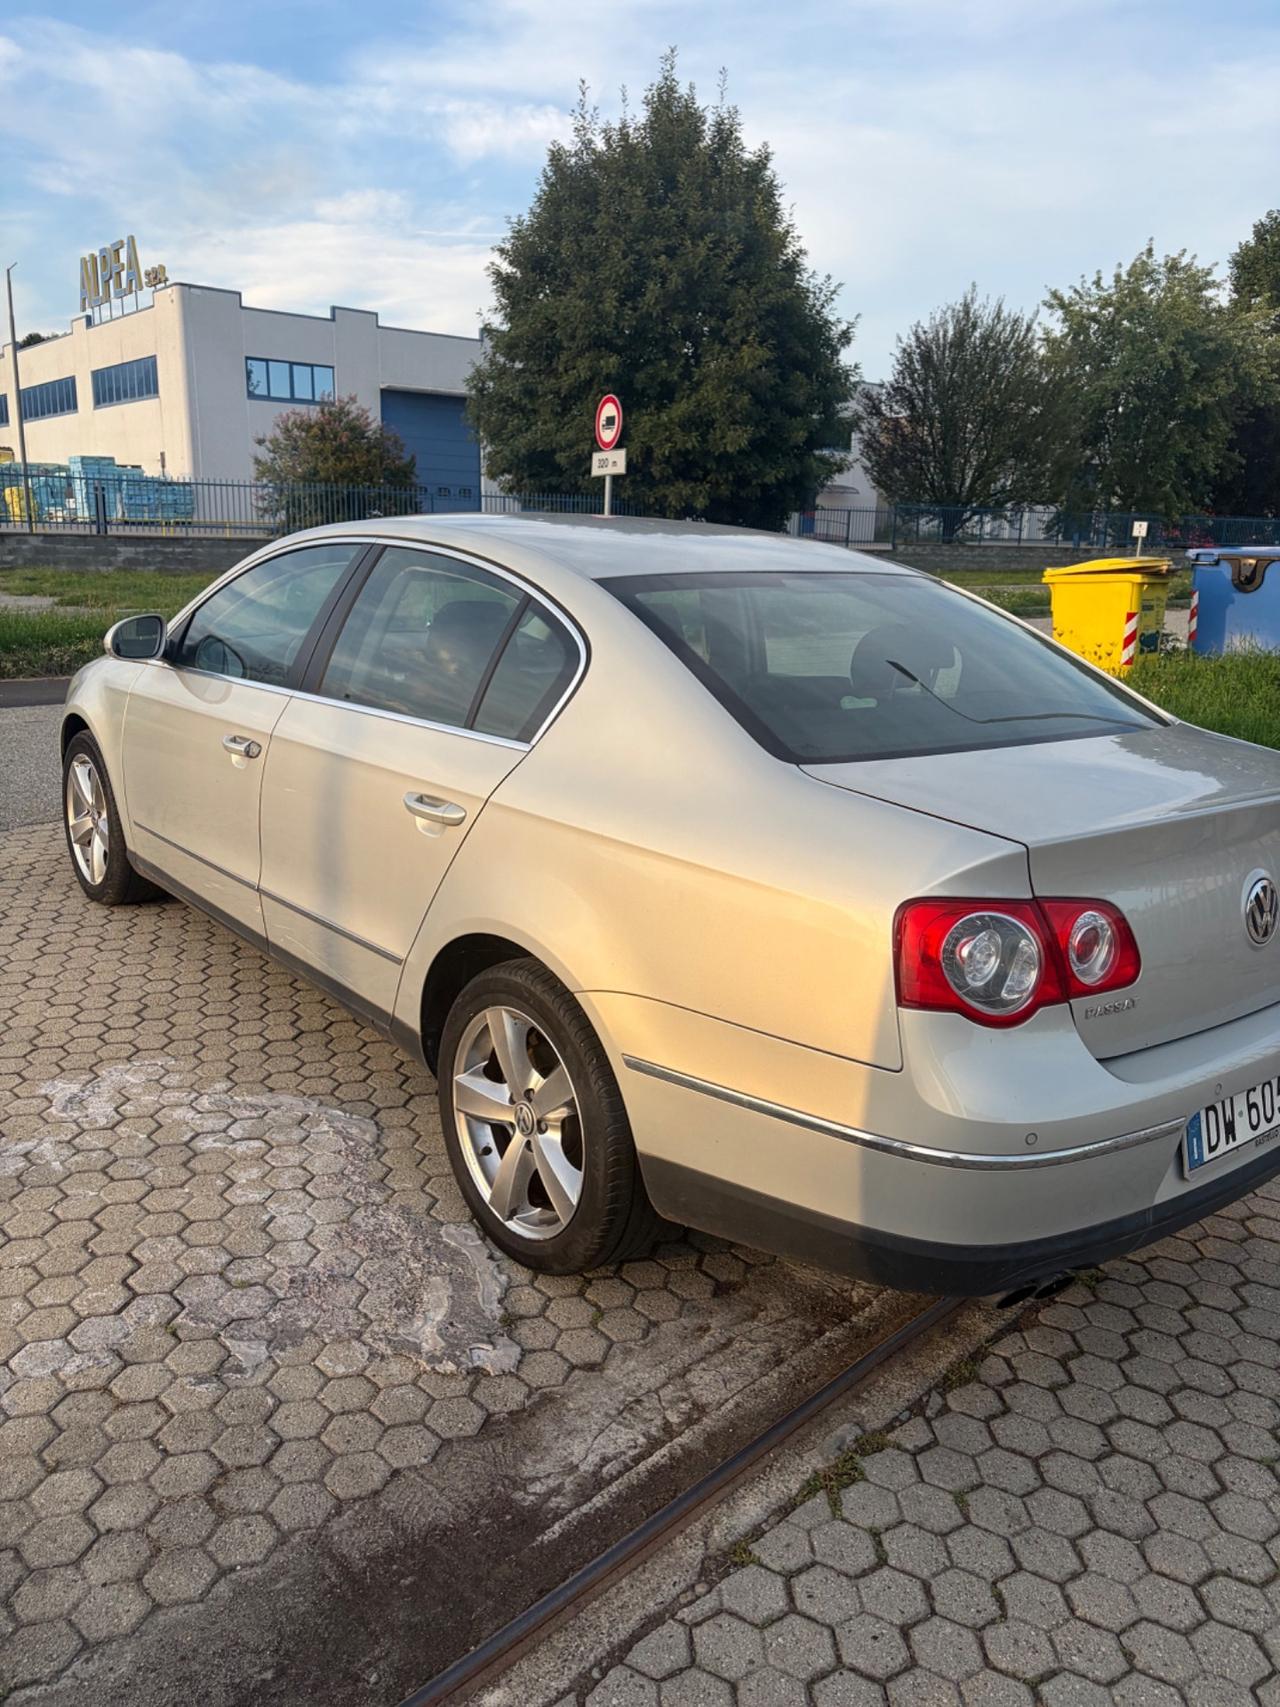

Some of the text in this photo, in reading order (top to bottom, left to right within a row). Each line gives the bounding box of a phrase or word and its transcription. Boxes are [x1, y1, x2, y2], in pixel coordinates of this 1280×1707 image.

[80, 235, 144, 312] ALPEA
[1084, 996, 1141, 1019] PASSAT
[1205, 1096, 1236, 1154] DW
